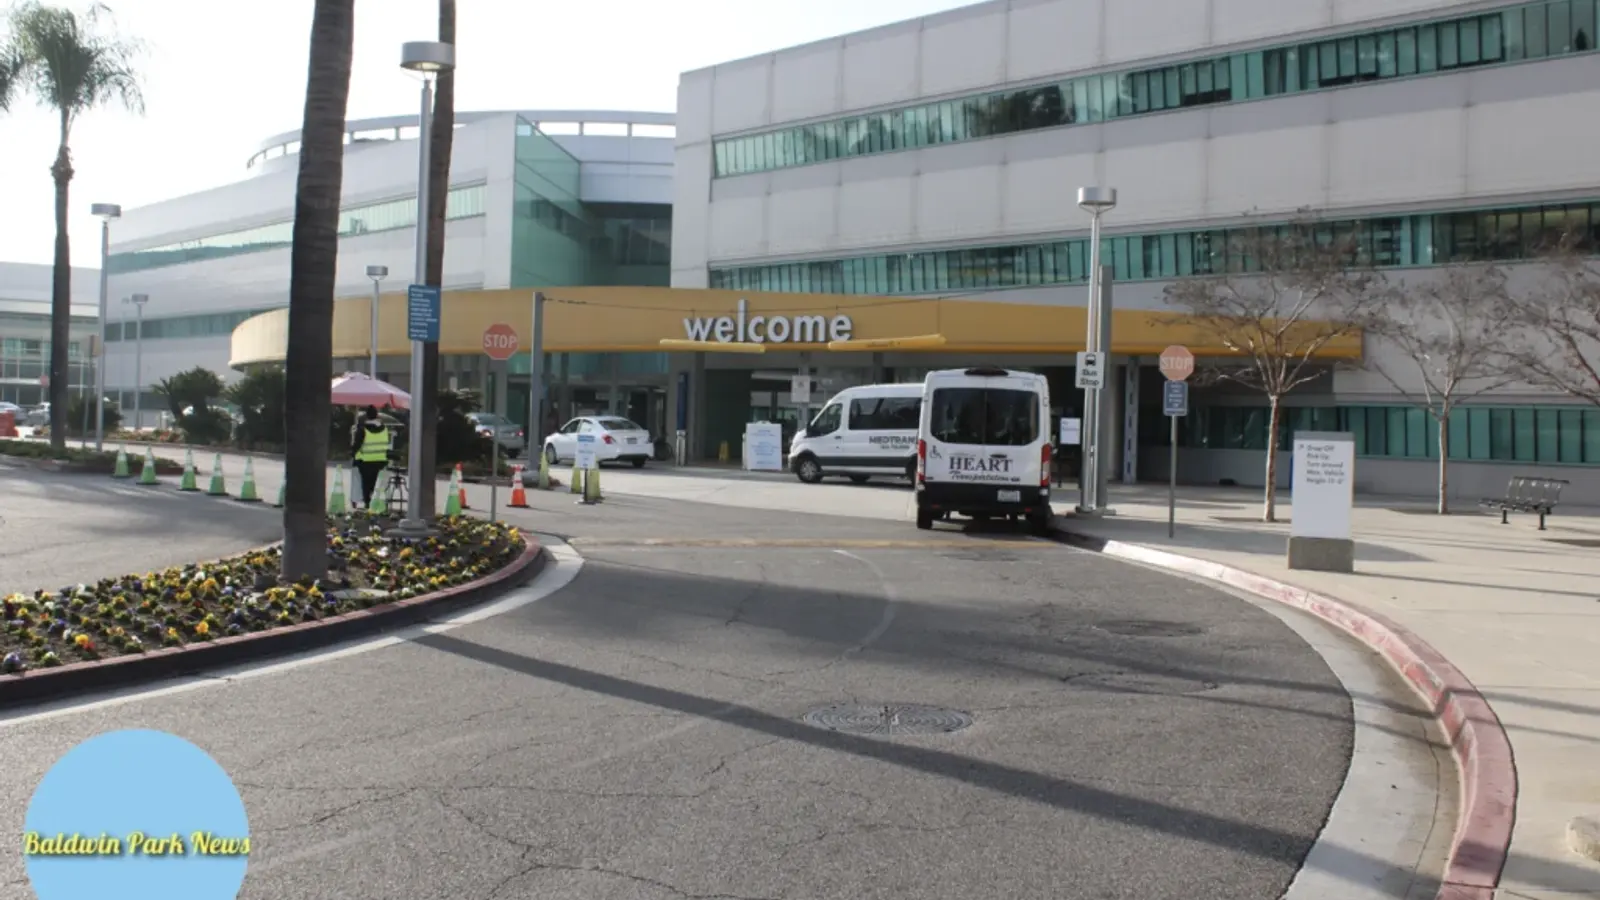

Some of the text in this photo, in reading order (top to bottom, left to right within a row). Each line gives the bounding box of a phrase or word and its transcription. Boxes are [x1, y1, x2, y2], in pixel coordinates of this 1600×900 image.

[683, 299, 853, 342] welcome
[484, 334, 517, 349] STOP
[1160, 355, 1193, 370] STOP
[1082, 368, 1098, 376] Bus
[1080, 377, 1100, 386] Stop
[949, 456, 1013, 472] HEART
